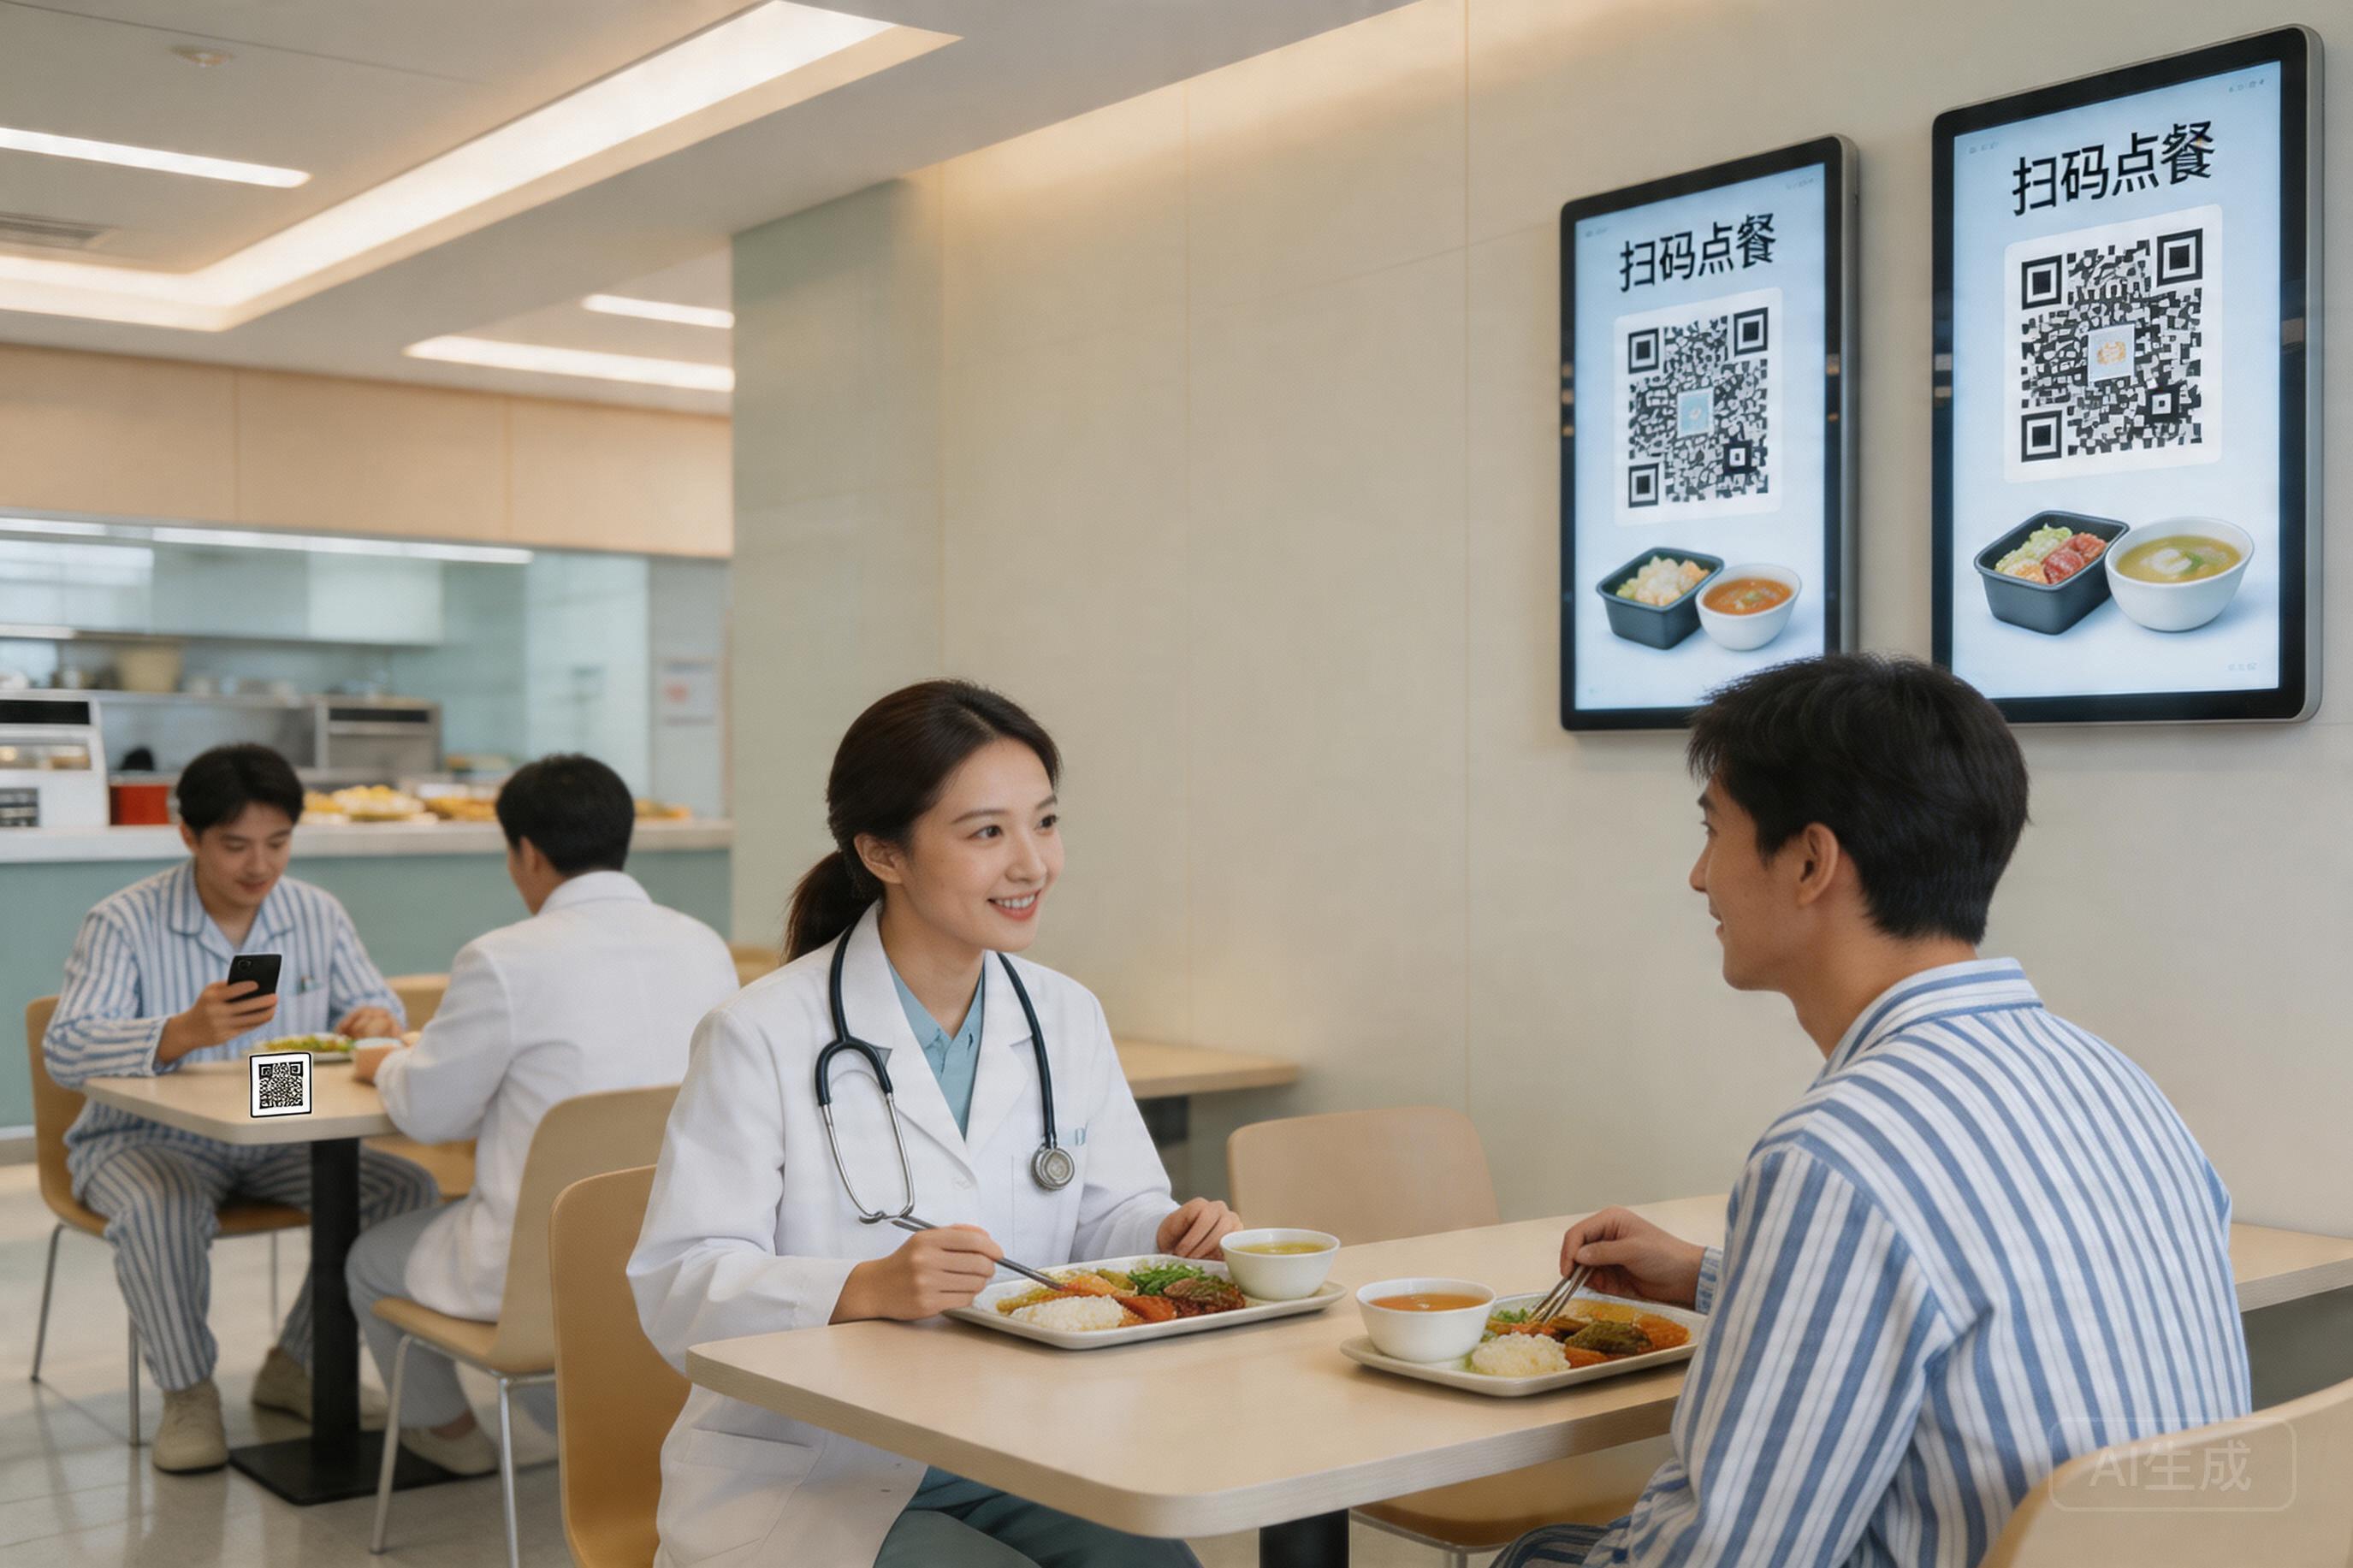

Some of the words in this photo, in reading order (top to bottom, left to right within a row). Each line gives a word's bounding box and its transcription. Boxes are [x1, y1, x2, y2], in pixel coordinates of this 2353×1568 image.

[2012, 120, 2216, 216] 扫码点餐
[1619, 212, 1776, 293] 扫码点餐
